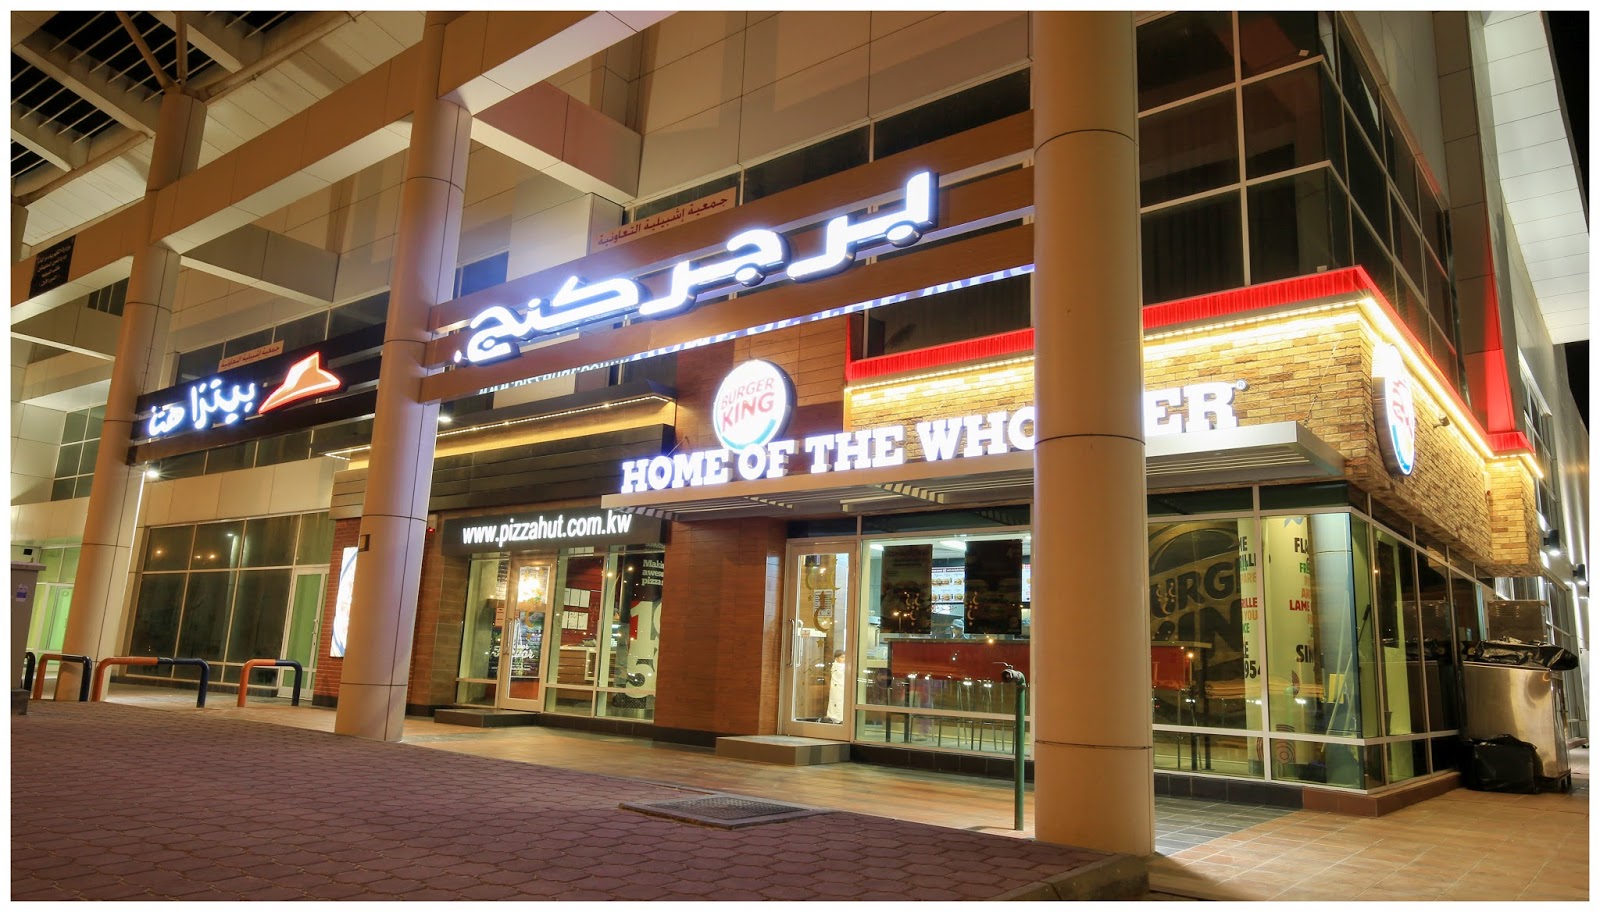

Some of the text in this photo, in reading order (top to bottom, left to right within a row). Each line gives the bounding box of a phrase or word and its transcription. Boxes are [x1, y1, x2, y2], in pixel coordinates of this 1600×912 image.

[687, 197, 728, 216] جمعية
[638, 169, 934, 316] برجر
[466, 275, 645, 364] كنج
[148, 378, 256, 436] بيتزا هت
[721, 377, 775, 410] BURGER
[722, 392, 776, 432] KING
[621, 449, 733, 494] HOME
[738, 440, 797, 480] OF
[805, 425, 907, 473] THE
[462, 509, 633, 547] www.pizzahut.com.kw
